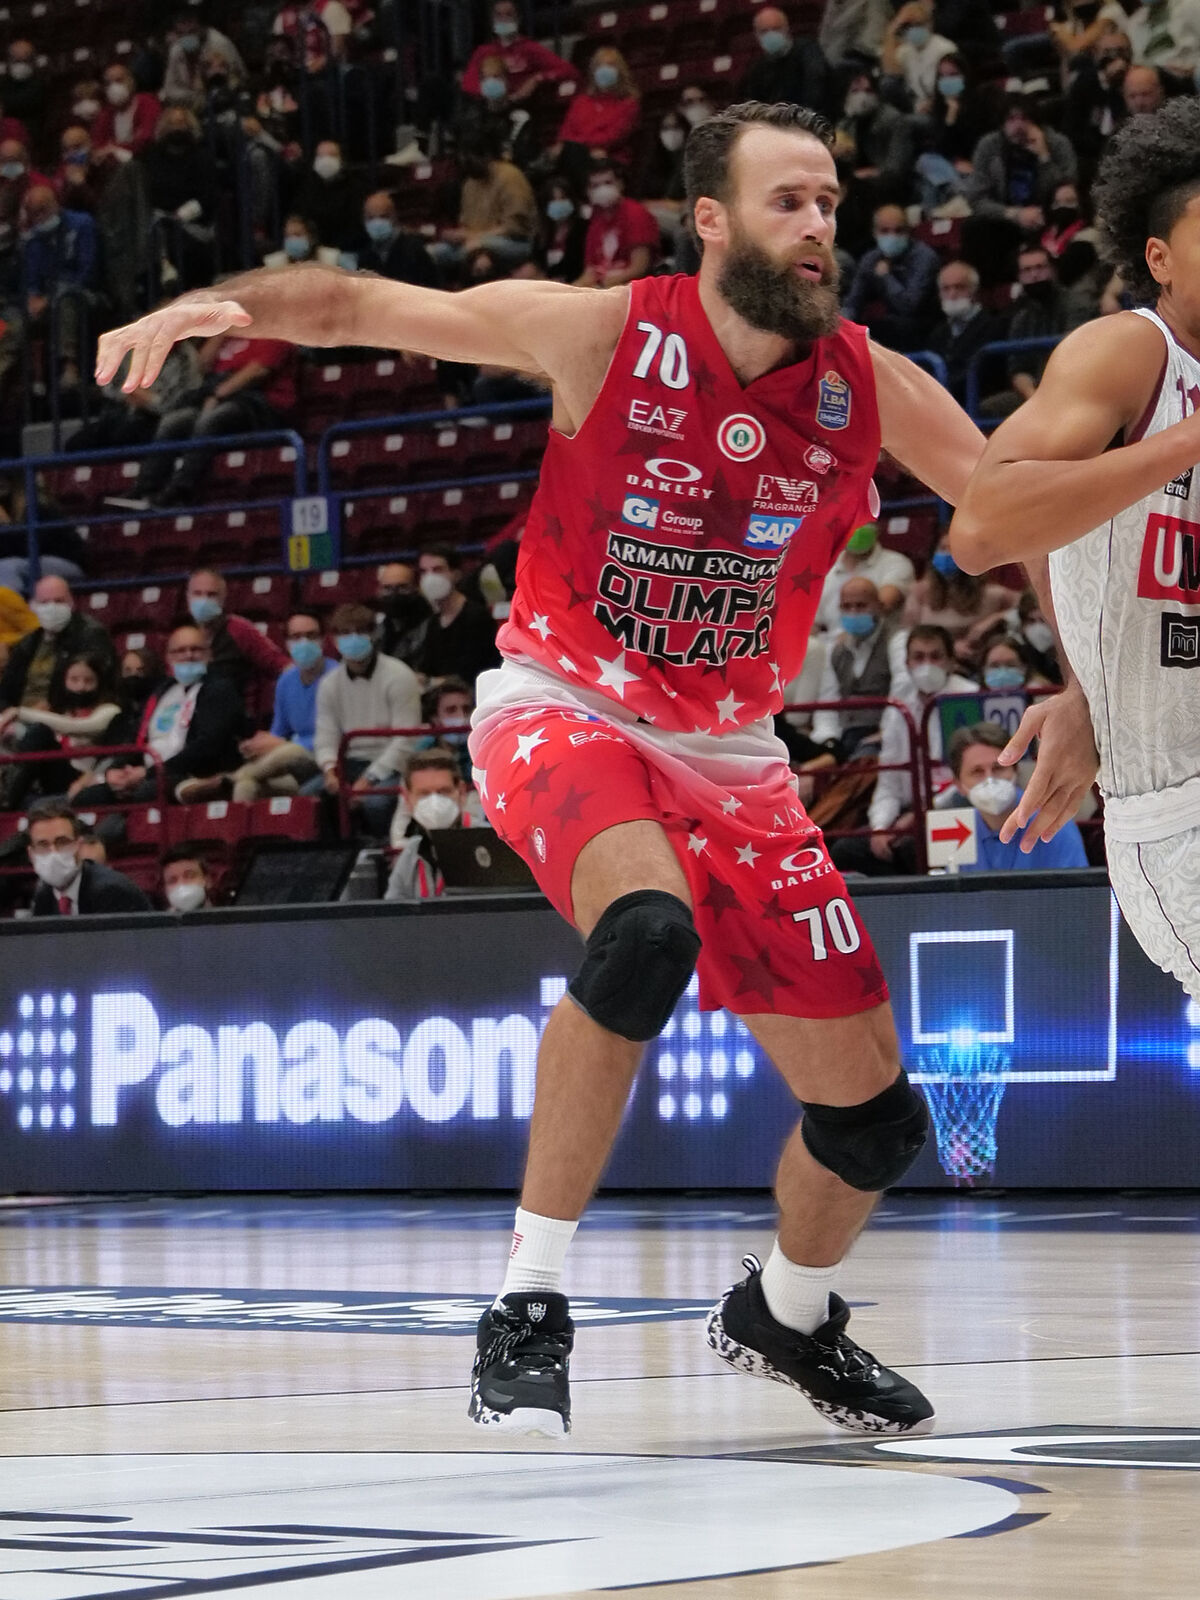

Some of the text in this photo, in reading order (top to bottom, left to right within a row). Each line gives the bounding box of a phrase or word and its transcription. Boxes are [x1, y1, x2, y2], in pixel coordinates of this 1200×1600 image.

[633, 321, 690, 390] 70
[824, 393, 847, 407] LBA
[629, 399, 689, 432] EA7
[626, 474, 714, 499] OAKLEY
[300, 504, 321, 528] 19
[662, 510, 703, 530] Group
[752, 500, 817, 513] FRAGRANCES
[746, 520, 797, 545] SAP
[611, 541, 695, 571] ARMANI
[598, 562, 777, 625] OLIMPA
[792, 897, 861, 962] 70
[91, 977, 570, 1127] Panason
